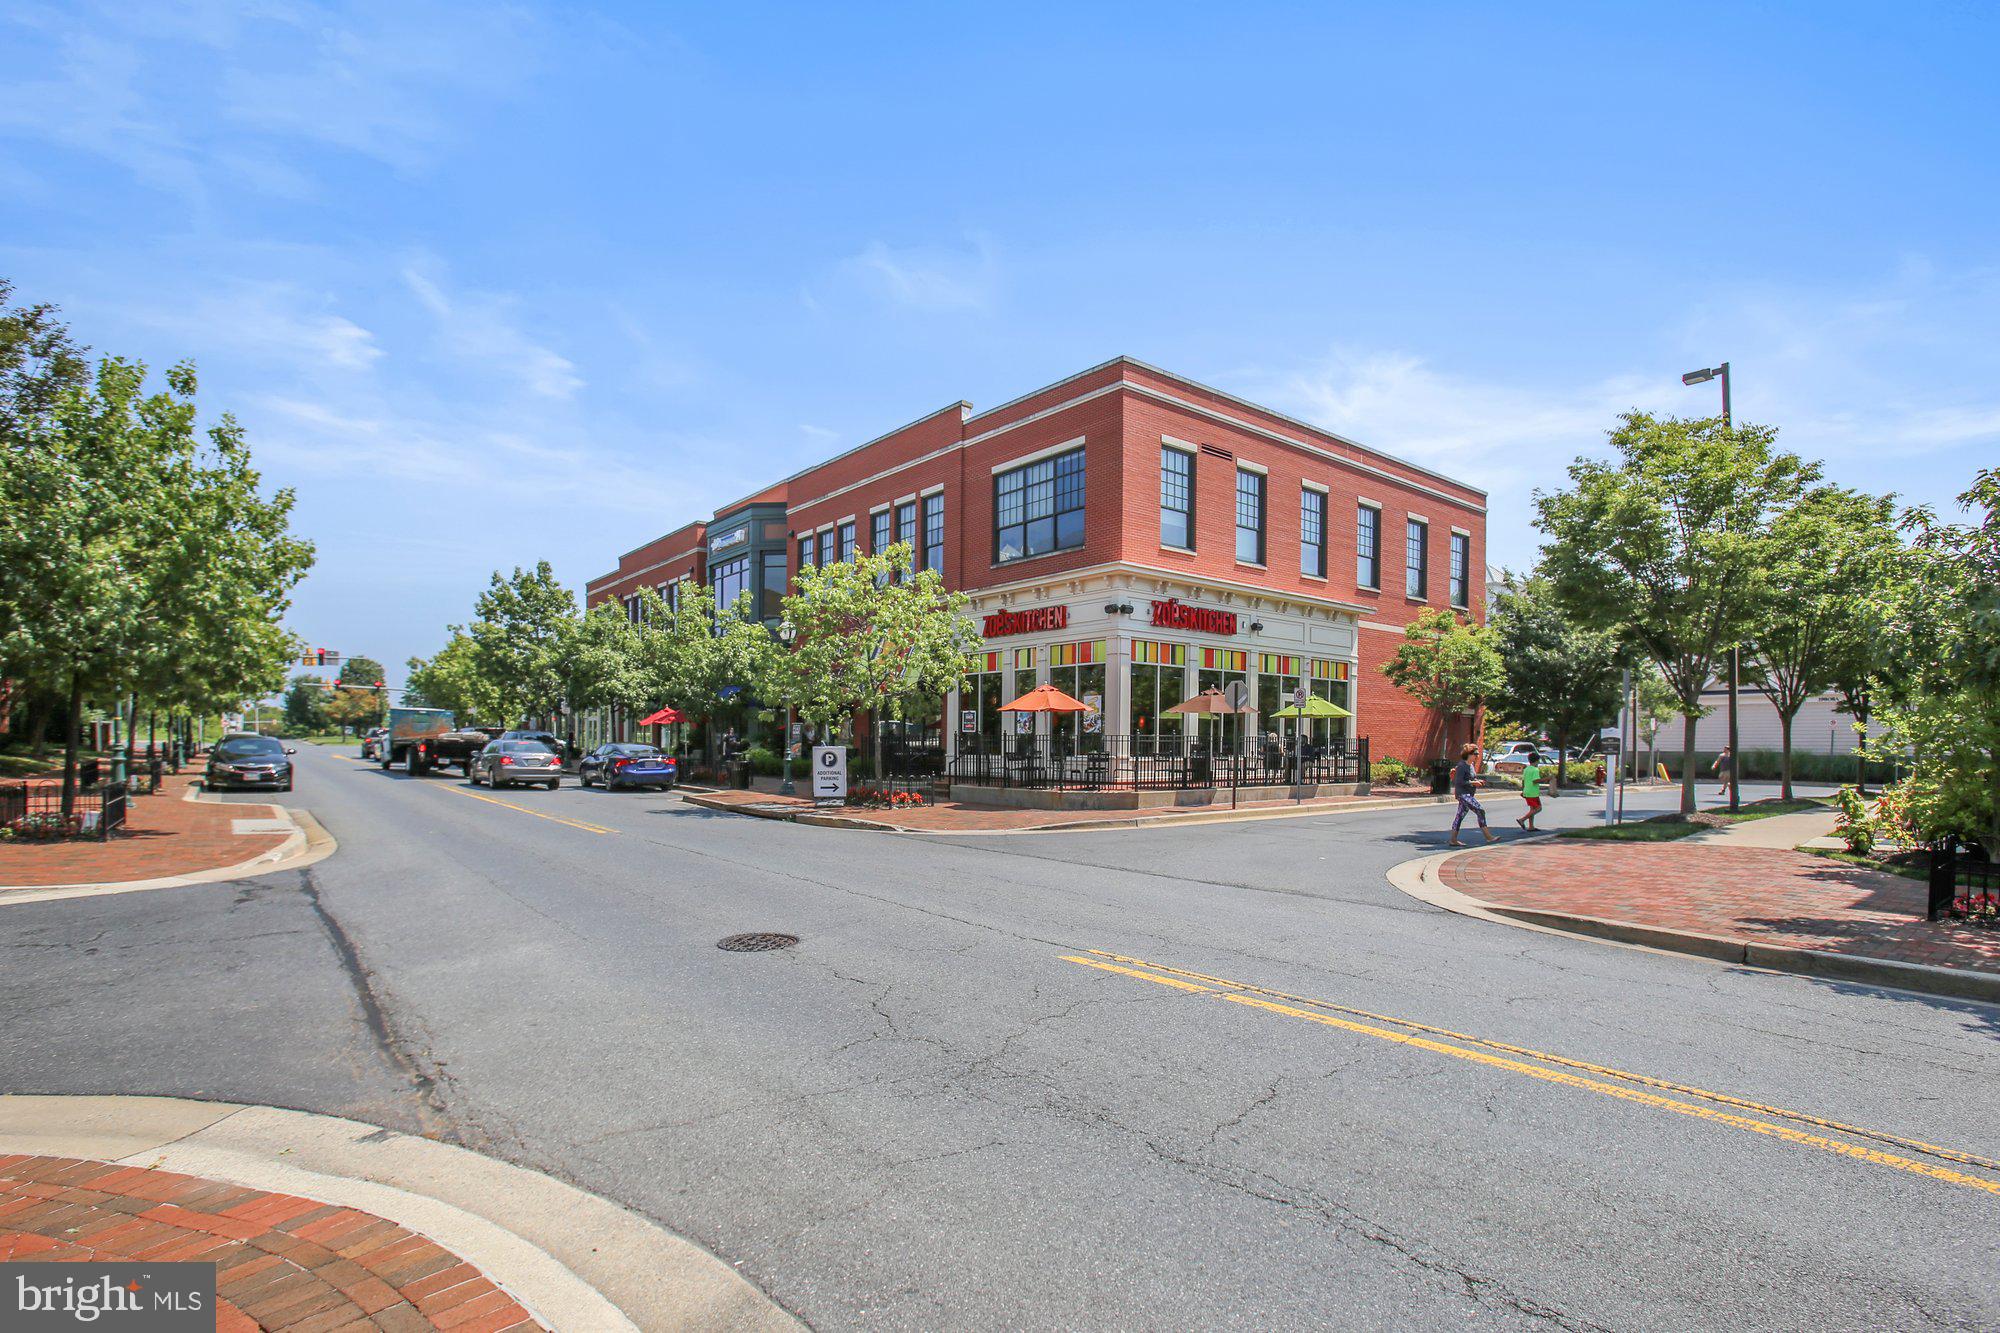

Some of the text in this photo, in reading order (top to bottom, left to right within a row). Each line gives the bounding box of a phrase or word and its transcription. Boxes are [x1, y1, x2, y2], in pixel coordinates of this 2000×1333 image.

[1012, 605, 1068, 634] KITCHEN
[1188, 606, 1237, 636] KITCHEN
[825, 753, 835, 766] P
